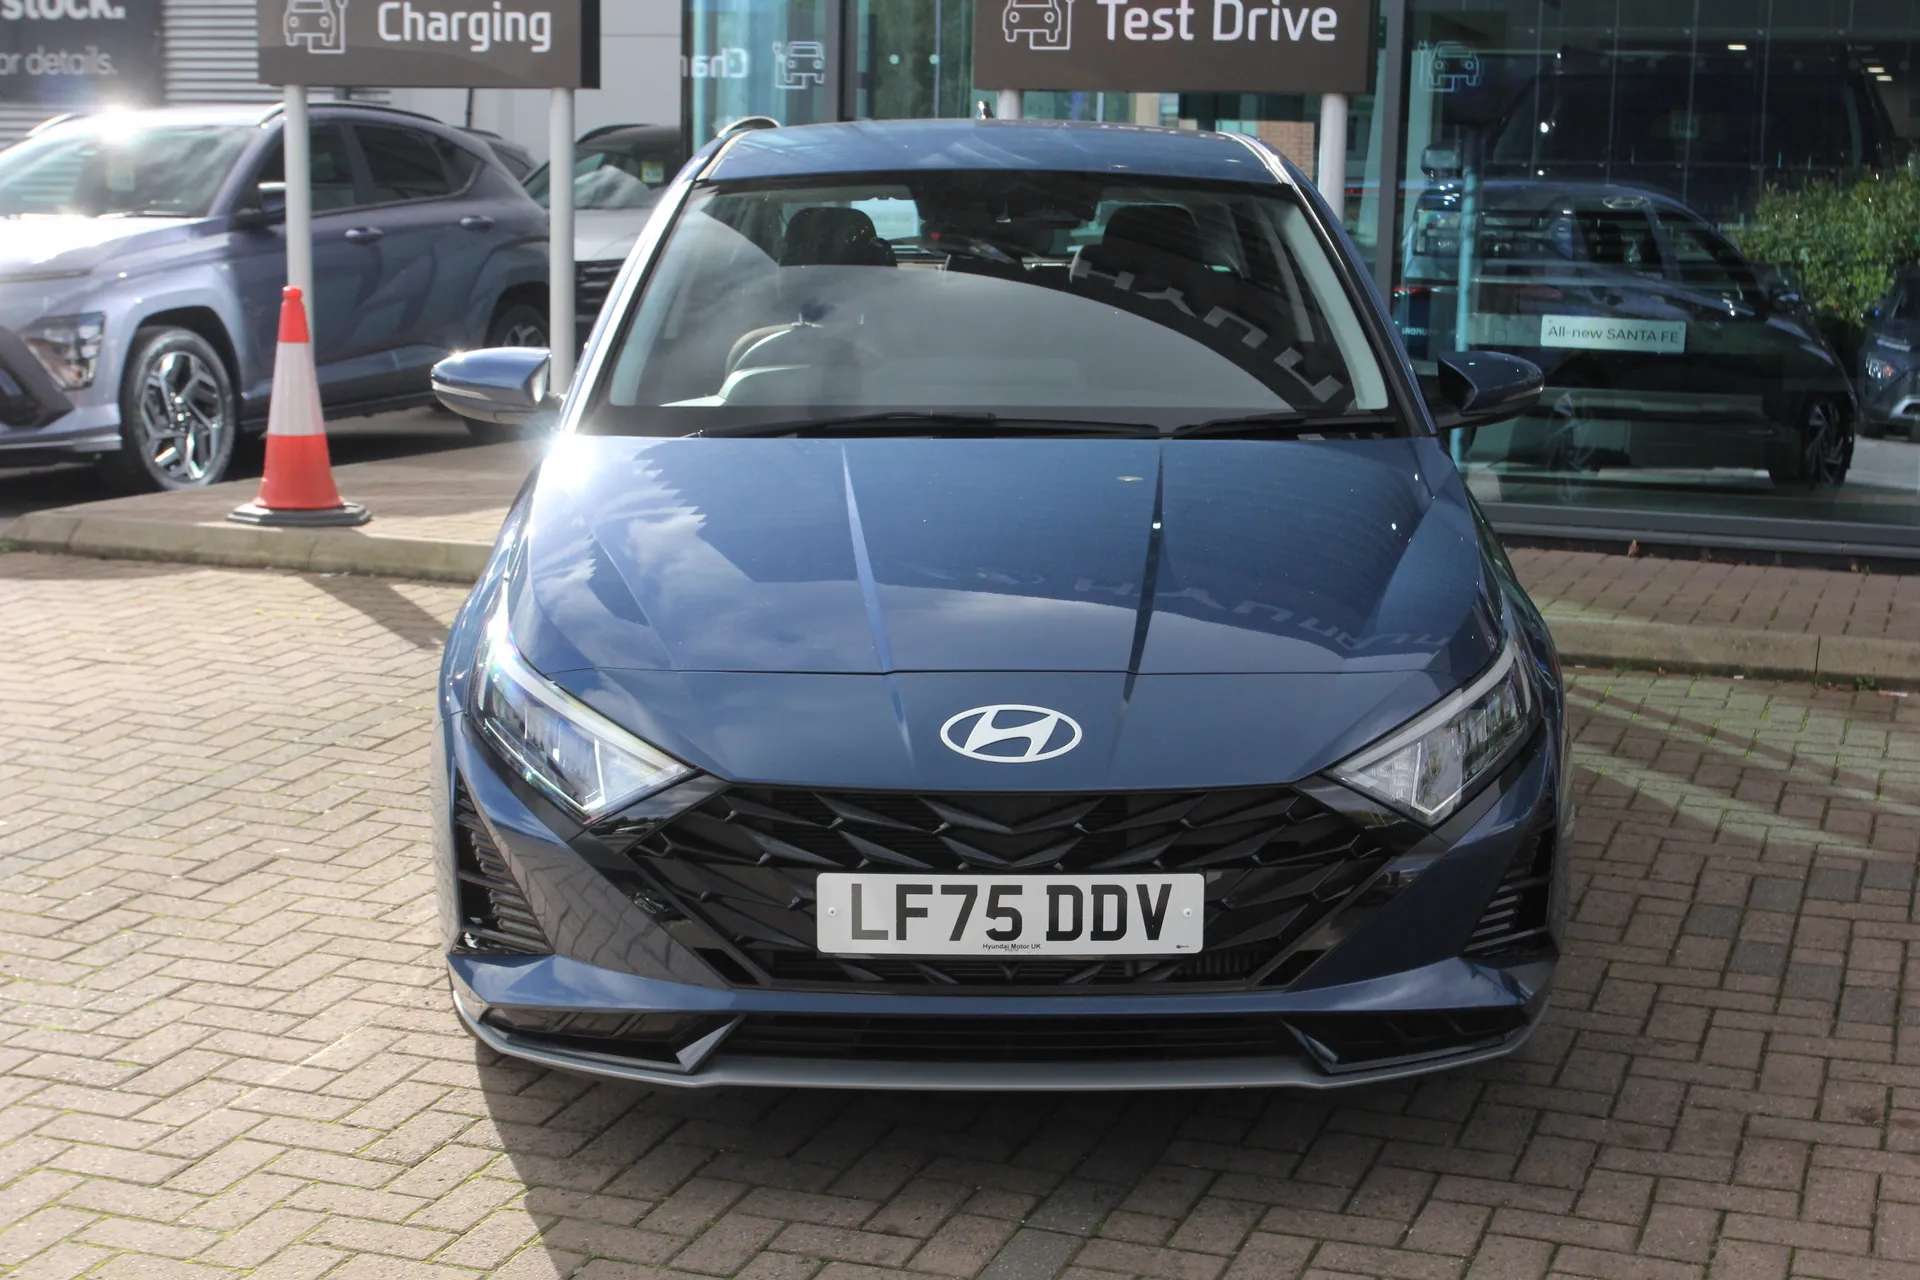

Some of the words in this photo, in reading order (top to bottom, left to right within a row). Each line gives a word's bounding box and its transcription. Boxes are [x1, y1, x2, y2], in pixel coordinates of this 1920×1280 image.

[377, 1, 552, 53] Charging
[1097, 0, 1195, 41] Test
[1212, 0, 1338, 41] Drive
[25, 45, 118, 76] details.
[1548, 325, 1603, 340] All-new
[1606, 328, 1657, 342] SANTA
[1660, 331, 1679, 344] FE
[851, 883, 1023, 942] LF75
[1045, 883, 1173, 942] DDV
[982, 943, 1009, 951] Hyundai
